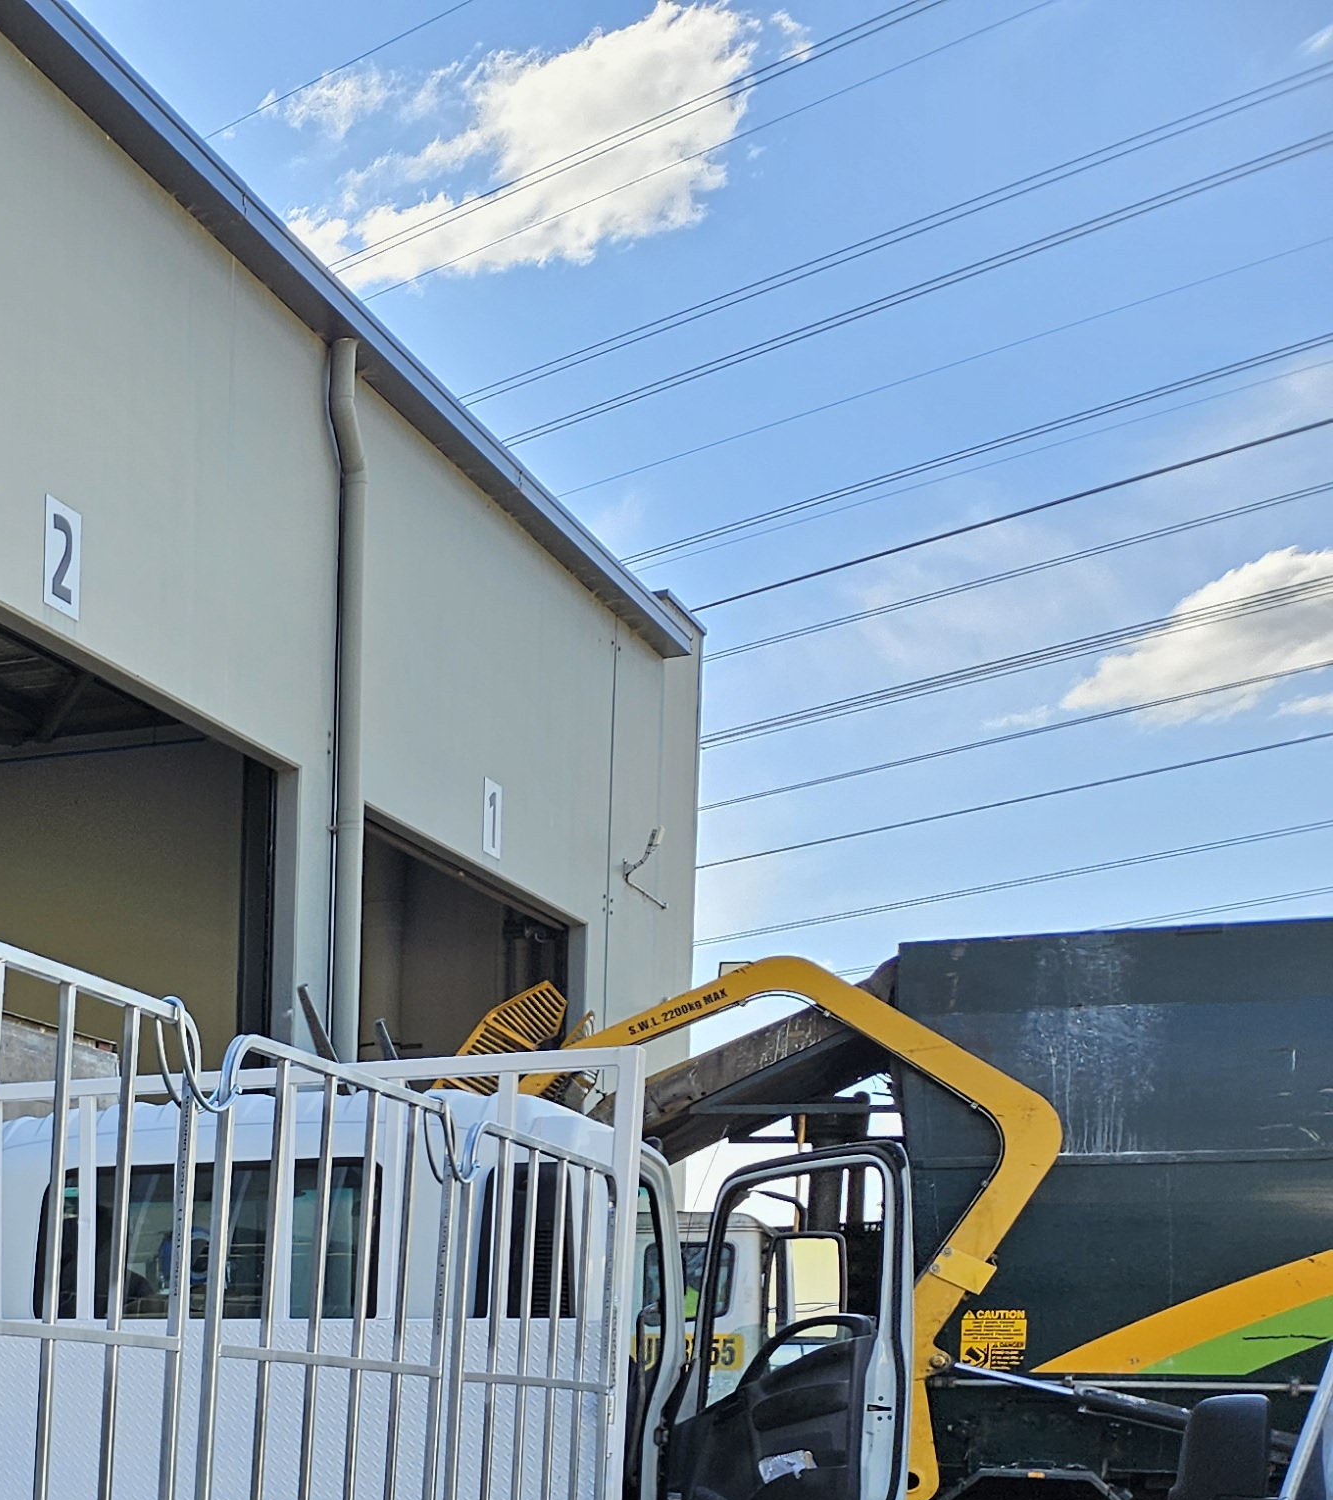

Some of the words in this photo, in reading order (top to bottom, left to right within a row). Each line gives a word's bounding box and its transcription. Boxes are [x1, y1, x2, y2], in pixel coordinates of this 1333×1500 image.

[51, 513, 73, 606] 2
[488, 791, 497, 849] 1
[702, 988, 729, 1006] MAX
[976, 1309, 1026, 1319] CAUTION
